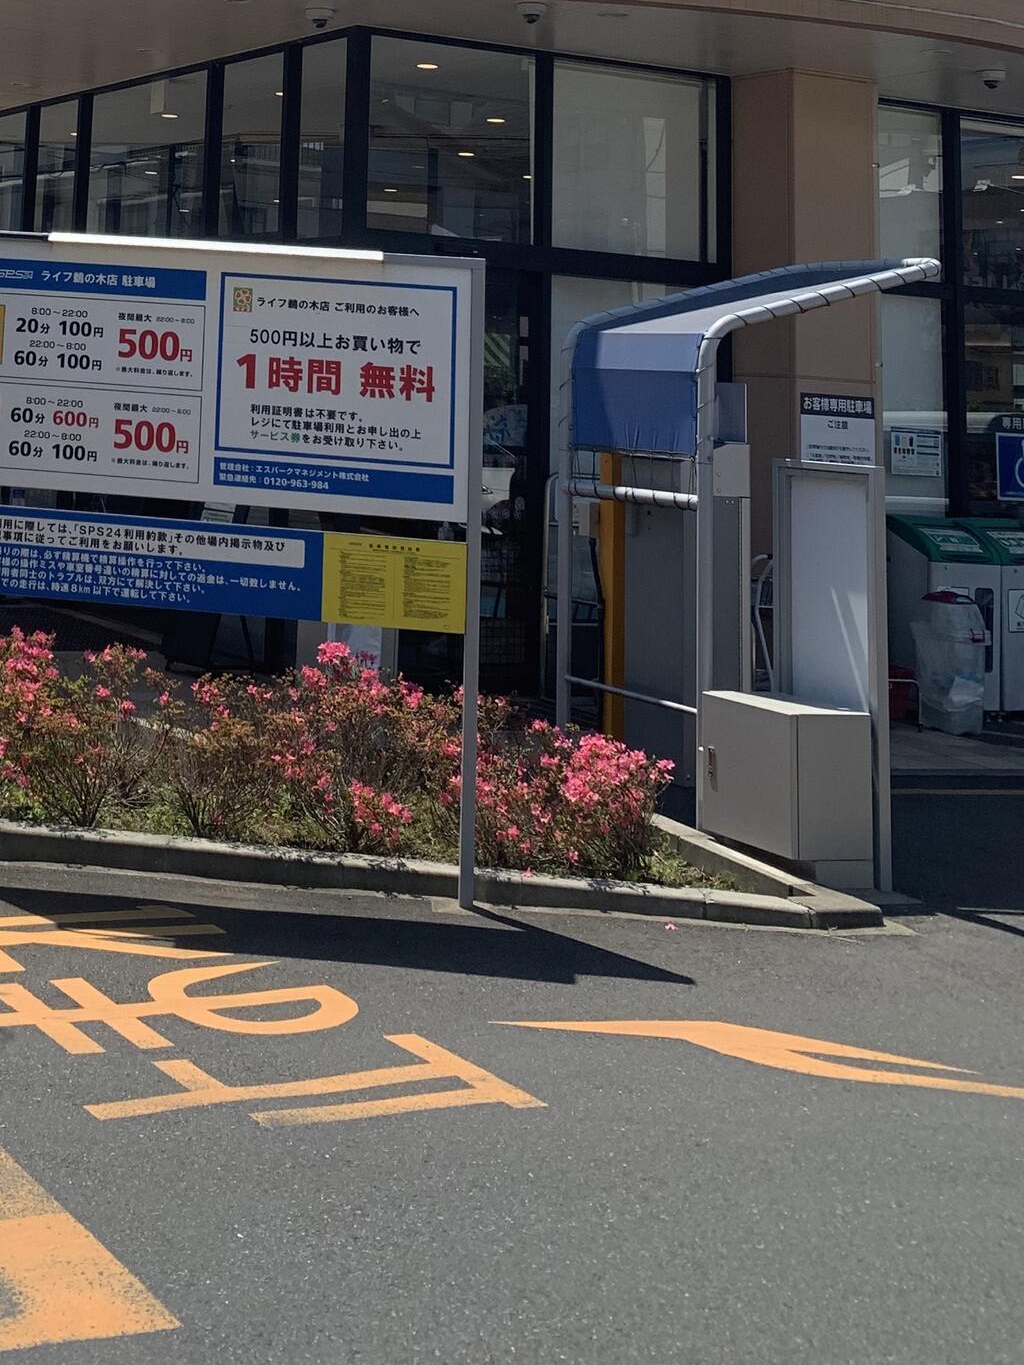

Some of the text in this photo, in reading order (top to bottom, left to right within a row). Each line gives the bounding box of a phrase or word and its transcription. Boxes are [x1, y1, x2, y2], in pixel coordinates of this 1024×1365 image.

[122, 276, 156, 289] 駐車場
[257, 296, 330, 312] ライフ鵜の木店
[335, 302, 420, 317] ご利用のお客様へ
[15, 318, 104, 338] 20分 100円
[118, 312, 152, 323] 夜間最大
[117, 328, 193, 362] 500円
[250, 329, 422, 354] 500円以上お買い物で
[14, 351, 102, 371] 60分 100円
[236, 353, 435, 402] 1時間 無料
[114, 402, 148, 413] 夜間最大
[250, 403, 363, 422] 利用証明書は不要です。
[803, 396, 872, 414] お客様専用駐車場
[11, 407, 99, 428] 60分 600円
[113, 419, 189, 454] 500円
[251, 417, 422, 440] レジにて駐車場利用とお申し出の上
[249, 429, 404, 451] サービス券をお受け取り下さい。
[9, 441, 97, 462] 60分 100円
